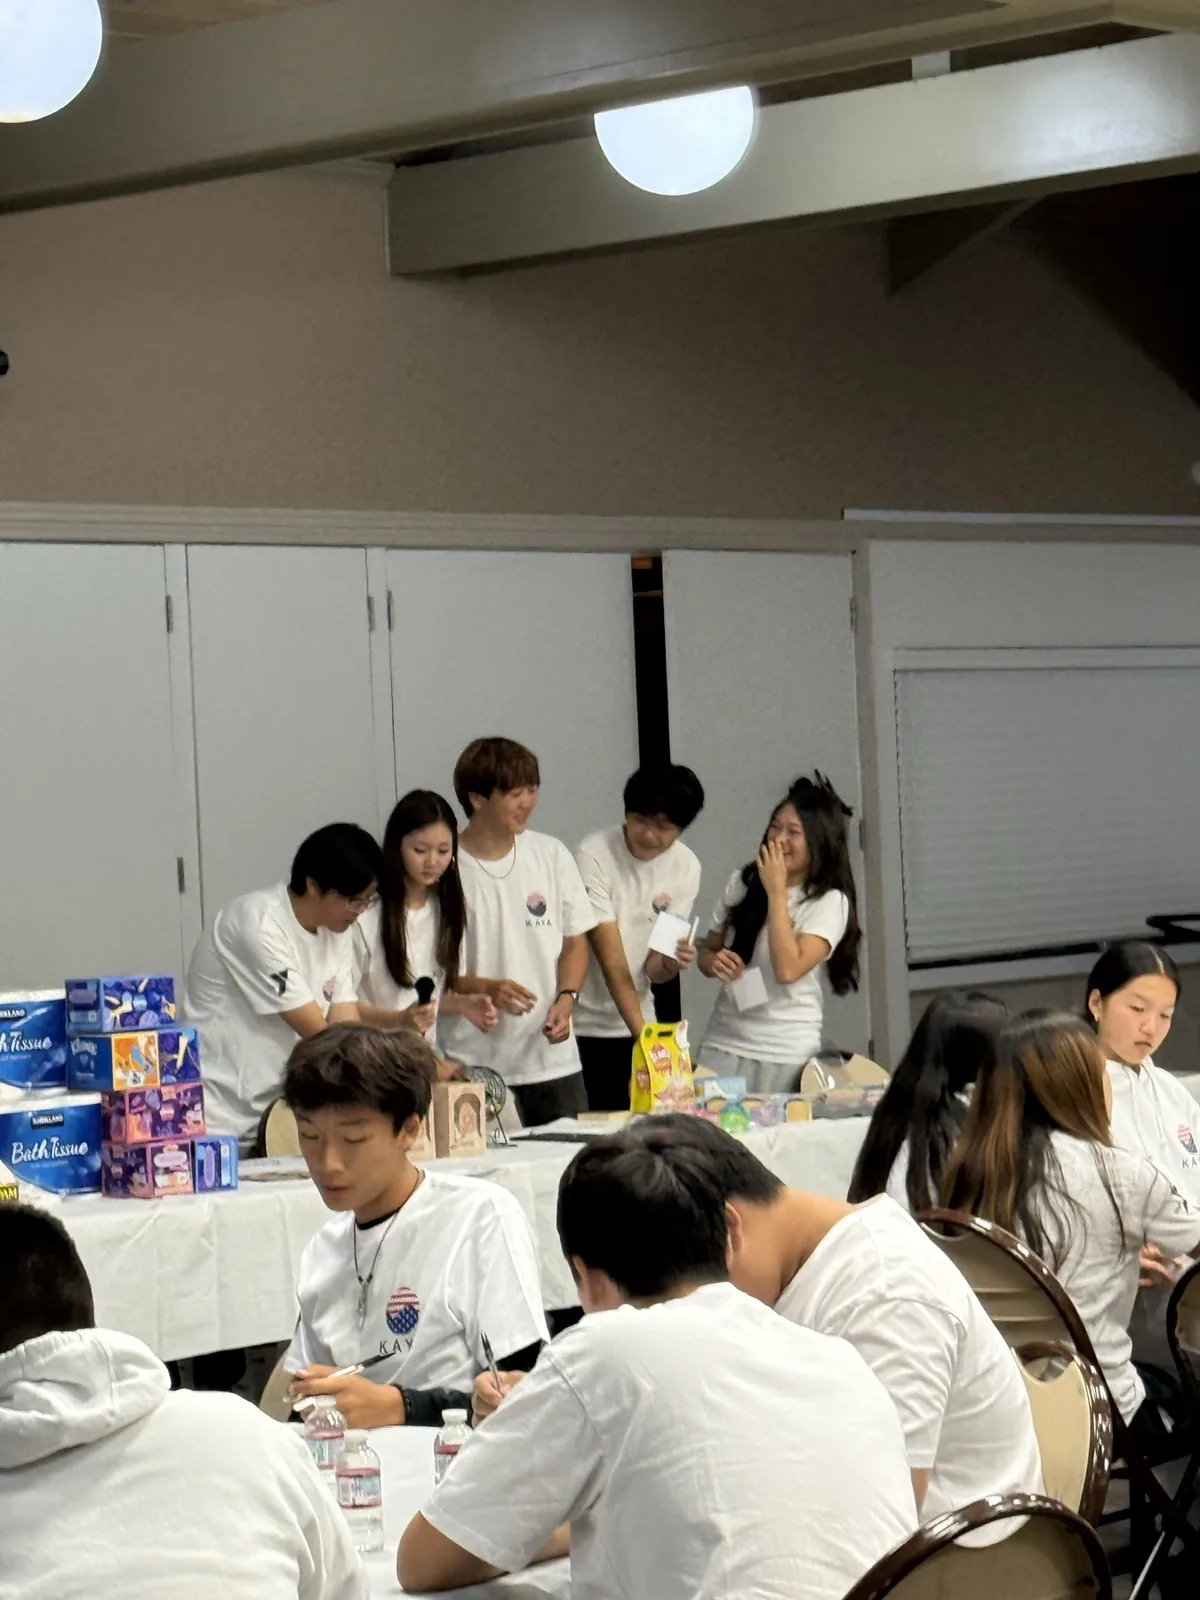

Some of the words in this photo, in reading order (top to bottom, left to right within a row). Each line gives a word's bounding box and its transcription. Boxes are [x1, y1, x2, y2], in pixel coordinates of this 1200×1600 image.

[10, 1031, 52, 1053] Tissue
[11, 1138, 51, 1165] Bath
[50, 1136, 89, 1159] Tissue
[1182, 1156, 1200, 1169] KA
